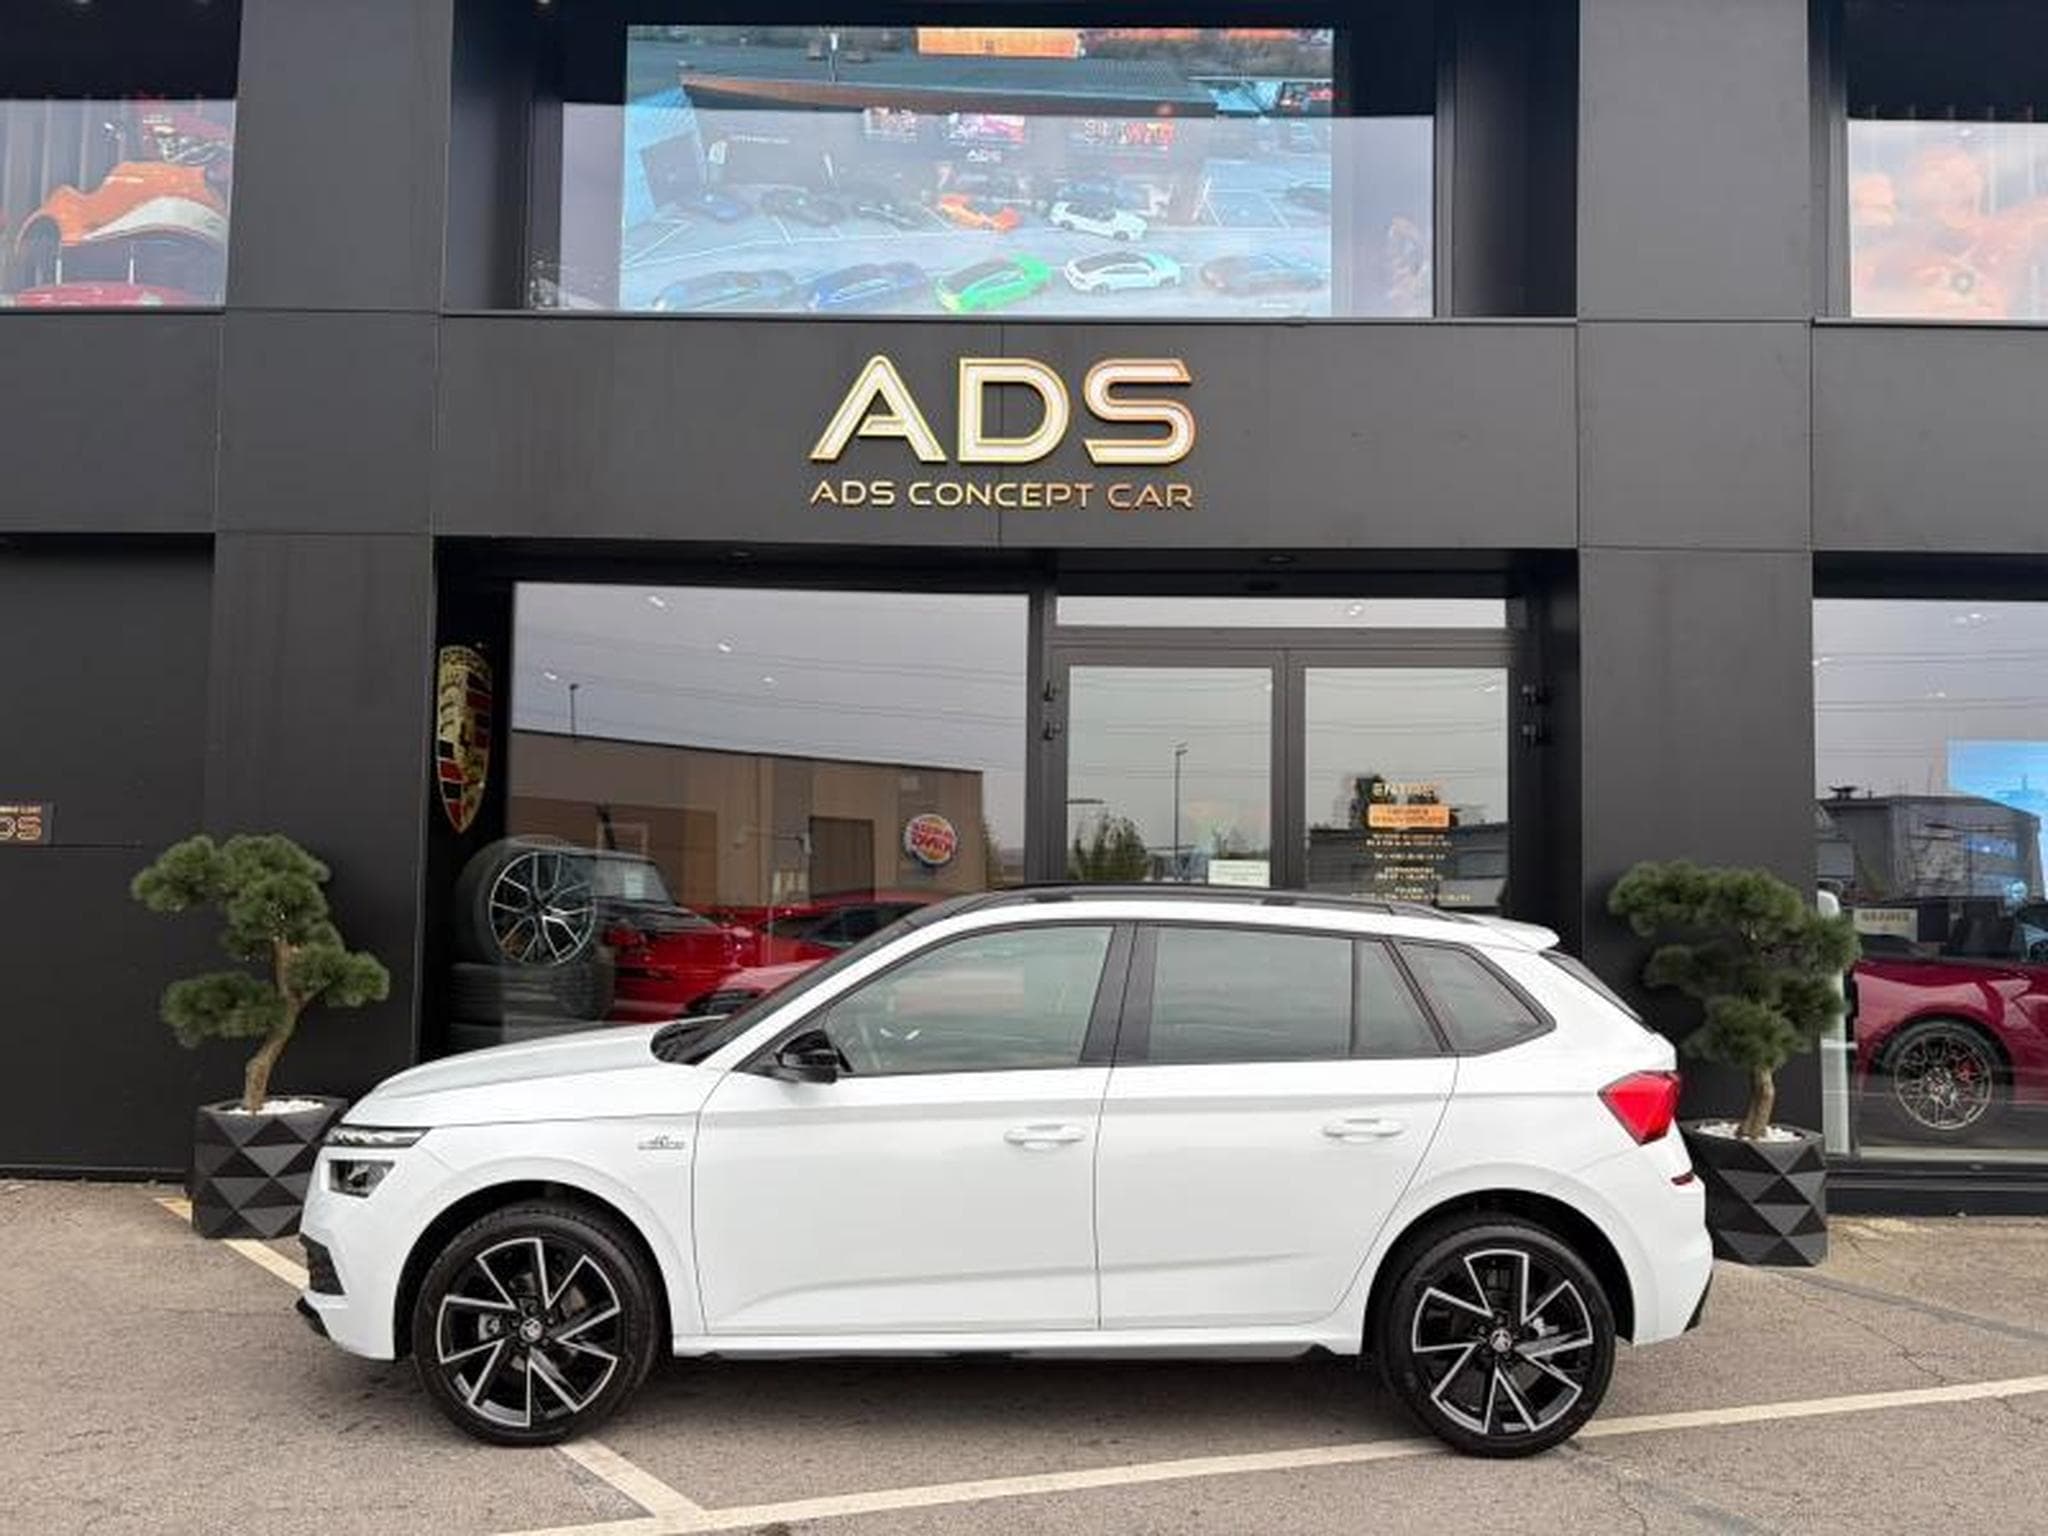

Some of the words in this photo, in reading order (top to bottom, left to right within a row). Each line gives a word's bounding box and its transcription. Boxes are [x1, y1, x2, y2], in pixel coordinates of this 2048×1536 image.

[808, 354, 1197, 466] ADS
[810, 481, 896, 507] ADS
[907, 482, 1094, 509] CONCEPT
[1107, 483, 1194, 510] CAR
